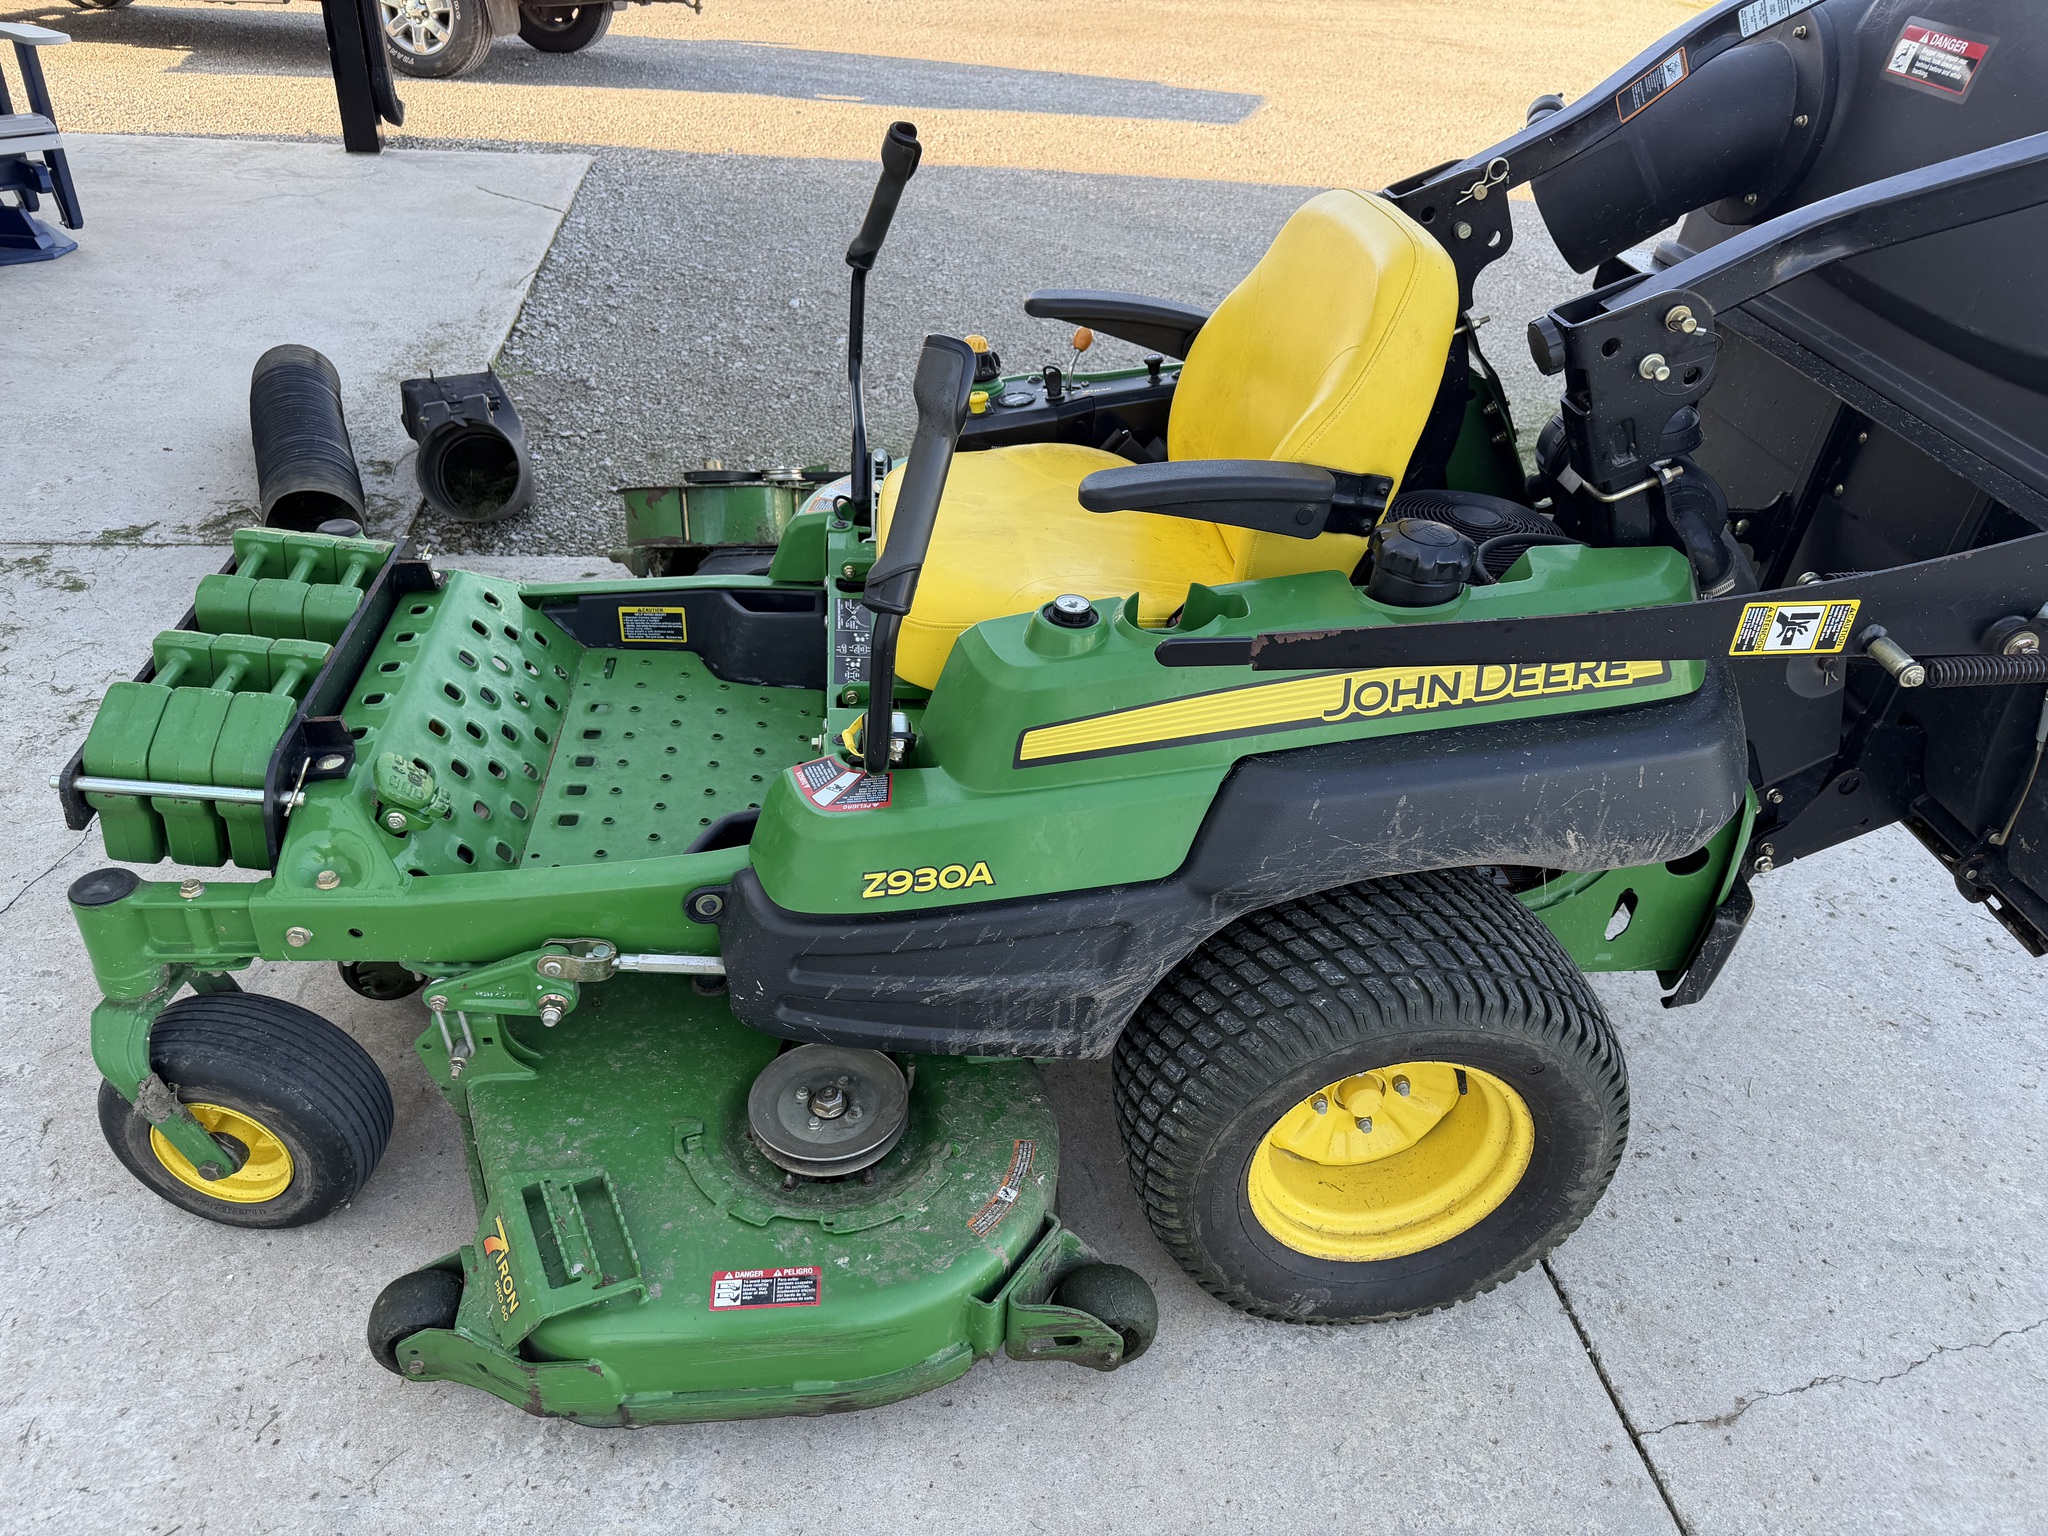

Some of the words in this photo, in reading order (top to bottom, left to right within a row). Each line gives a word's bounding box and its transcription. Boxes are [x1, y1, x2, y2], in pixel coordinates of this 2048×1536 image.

[1929, 34, 1969, 54] DANGER
[1755, 614, 1772, 651] ATENCION
[1837, 613, 1853, 646] CAUTION
[1322, 671, 1464, 720] JOHN
[1472, 661, 1634, 702] DEERE
[862, 861, 996, 899] Z930A
[784, 1267, 813, 1275] PELIGRO
[494, 1280, 504, 1304] PRO
